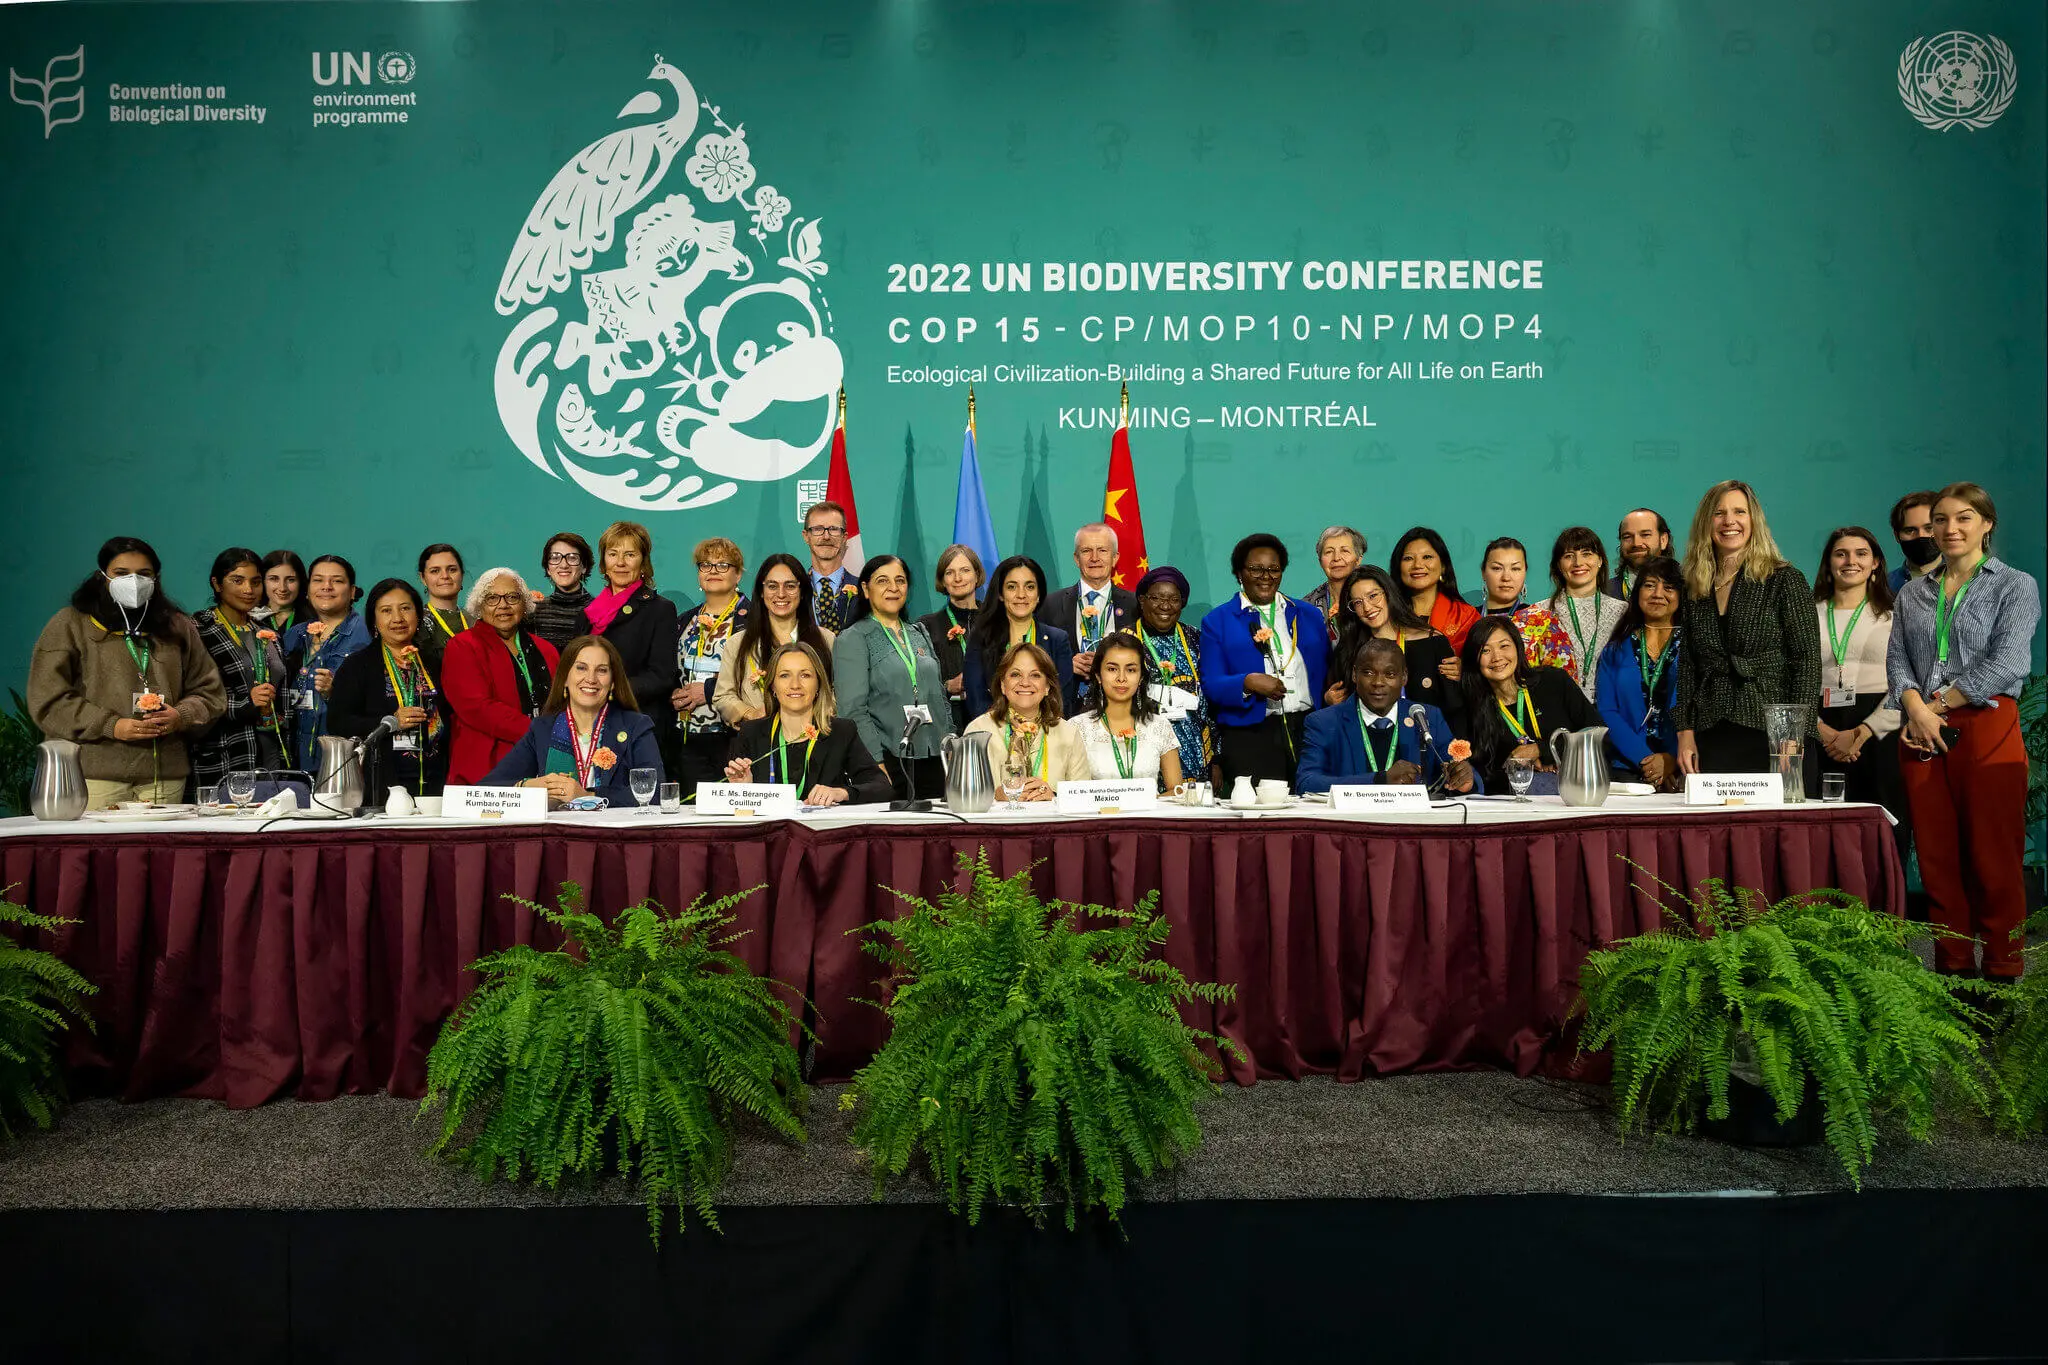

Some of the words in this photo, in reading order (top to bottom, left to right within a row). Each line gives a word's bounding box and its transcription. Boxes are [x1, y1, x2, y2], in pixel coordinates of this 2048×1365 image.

[311, 51, 371, 86] UN
[109, 83, 202, 100] Convention
[206, 86, 226, 100] on
[312, 91, 417, 107] environment
[109, 104, 190, 125] Biological
[193, 104, 267, 124] Diversity
[312, 111, 409, 128] programme
[887, 263, 971, 293] 2022
[982, 262, 1031, 292] UN
[1043, 261, 1293, 292] BIODIVERSITY
[1302, 260, 1543, 291] CONFERENCE
[888, 317, 977, 344] COP
[995, 317, 1040, 343] 15
[887, 364, 987, 388] Ecological
[994, 363, 1185, 387] Civilization-Building
[1191, 367, 1204, 381] a
[1210, 362, 1281, 381] Shared
[1288, 362, 1351, 381] Future
[1356, 361, 1384, 380] for
[1387, 361, 1412, 380] All
[1419, 361, 1454, 379] Life
[1459, 365, 1484, 379] on
[1491, 361, 1543, 379] Earth
[1059, 406, 1191, 429] KUNMING
[1221, 400, 1377, 428] MONTRÉAL
[466, 790, 482, 798] H.E.
[498, 791, 521, 799] Mirela
[729, 799, 762, 807] Couillard
[742, 790, 780, 799] Bérangère
[1094, 794, 1120, 802] México
[465, 799, 500, 807] Kumbaro
[501, 800, 521, 808] Furxi
